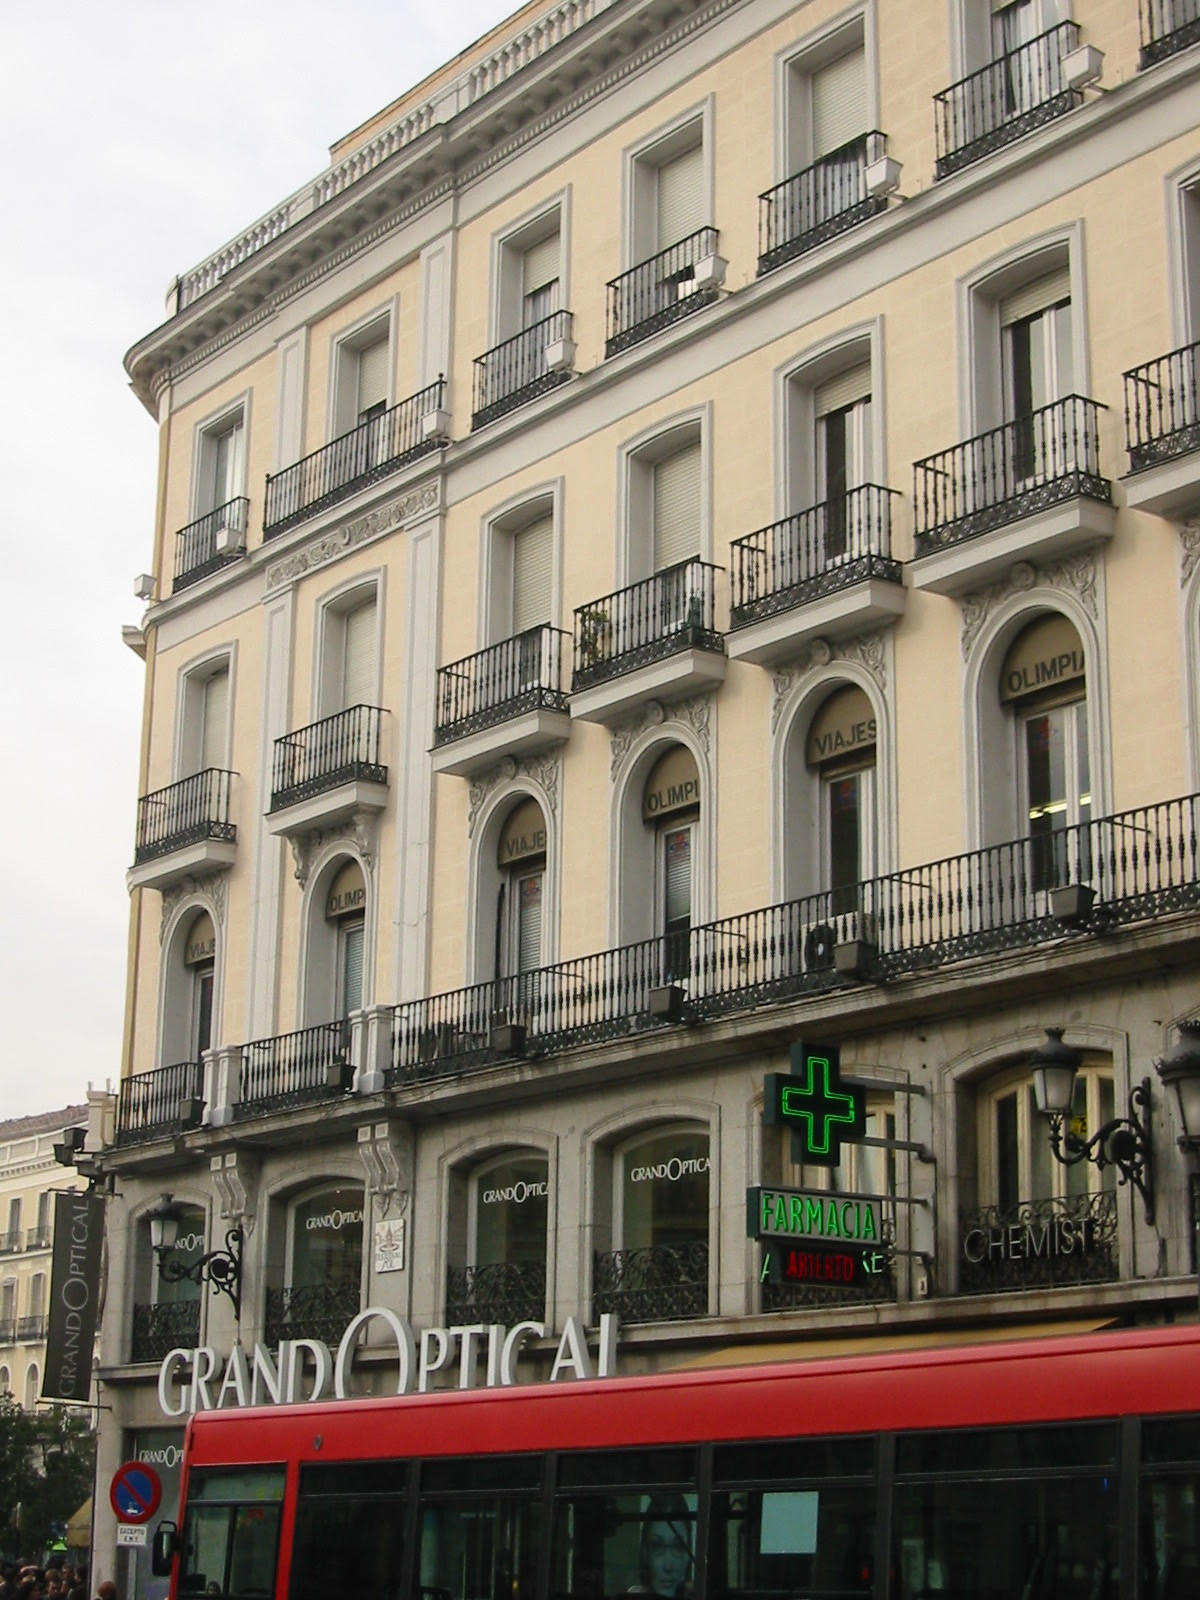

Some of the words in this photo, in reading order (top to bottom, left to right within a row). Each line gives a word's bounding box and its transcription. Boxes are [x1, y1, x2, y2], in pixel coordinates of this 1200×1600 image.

[331, 888, 366, 911] OLIMP
[762, 1192, 877, 1241] FARMACIA
[964, 1217, 1089, 1263] CHEMIST
[59, 1200, 89, 1396] GRANDOPTICAL
